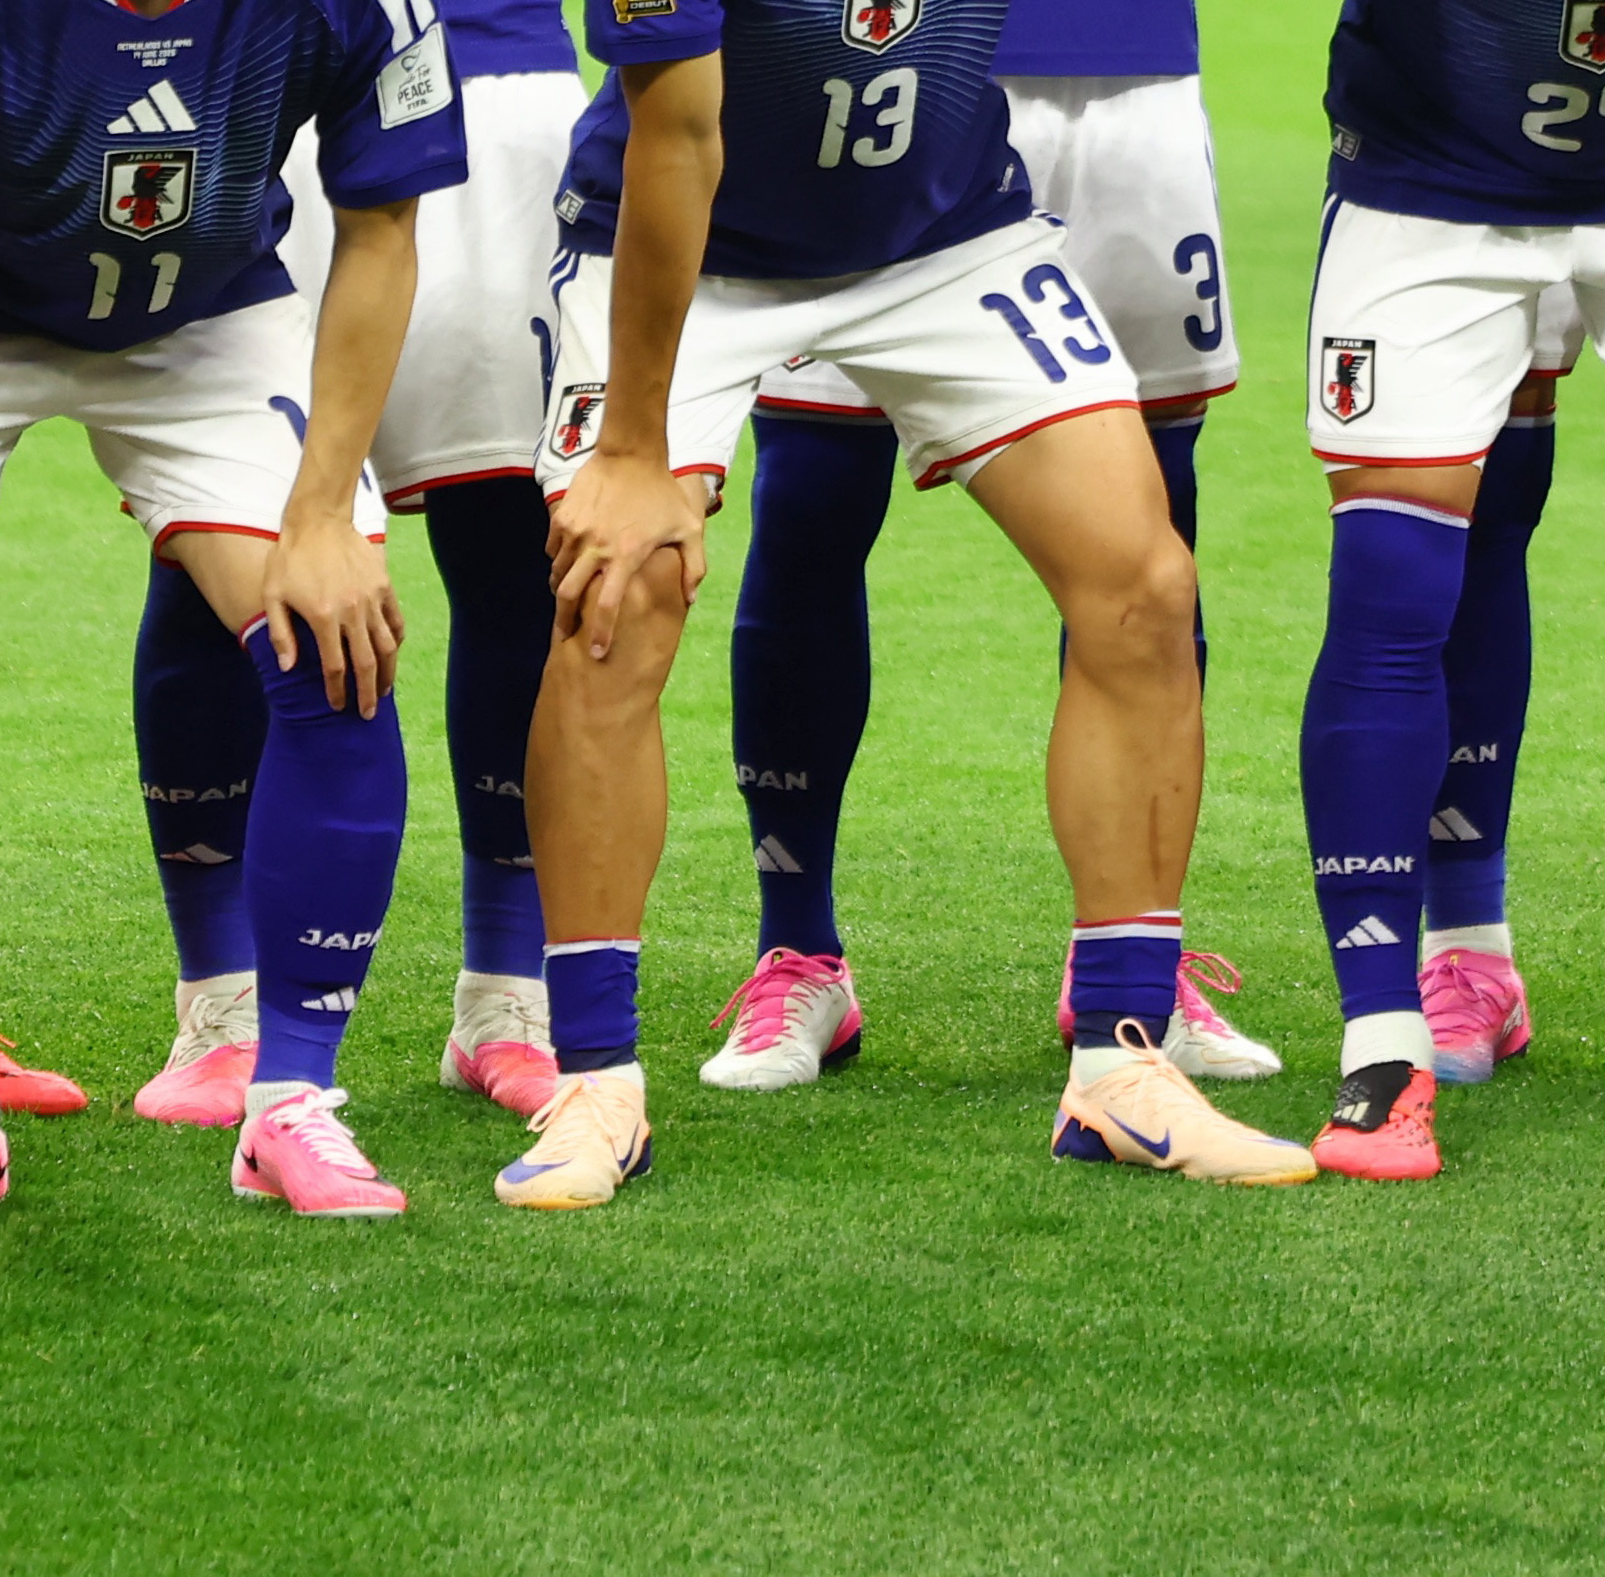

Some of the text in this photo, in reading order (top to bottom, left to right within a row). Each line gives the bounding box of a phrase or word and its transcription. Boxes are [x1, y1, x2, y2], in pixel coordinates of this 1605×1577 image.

[397, 79, 433, 104] PEACE
[816, 67, 918, 169] 13
[128, 153, 174, 163] JAPAN
[87, 251, 182, 321] 11
[1171, 232, 1224, 354] 3
[979, 263, 1113, 385] 13
[1332, 339, 1364, 349] JAPAN
[571, 383, 603, 393] JAPAN
[737, 764, 808, 791] PAN
[1313, 856, 1417, 876] JAPAN
[298, 929, 384, 951] JAPA
